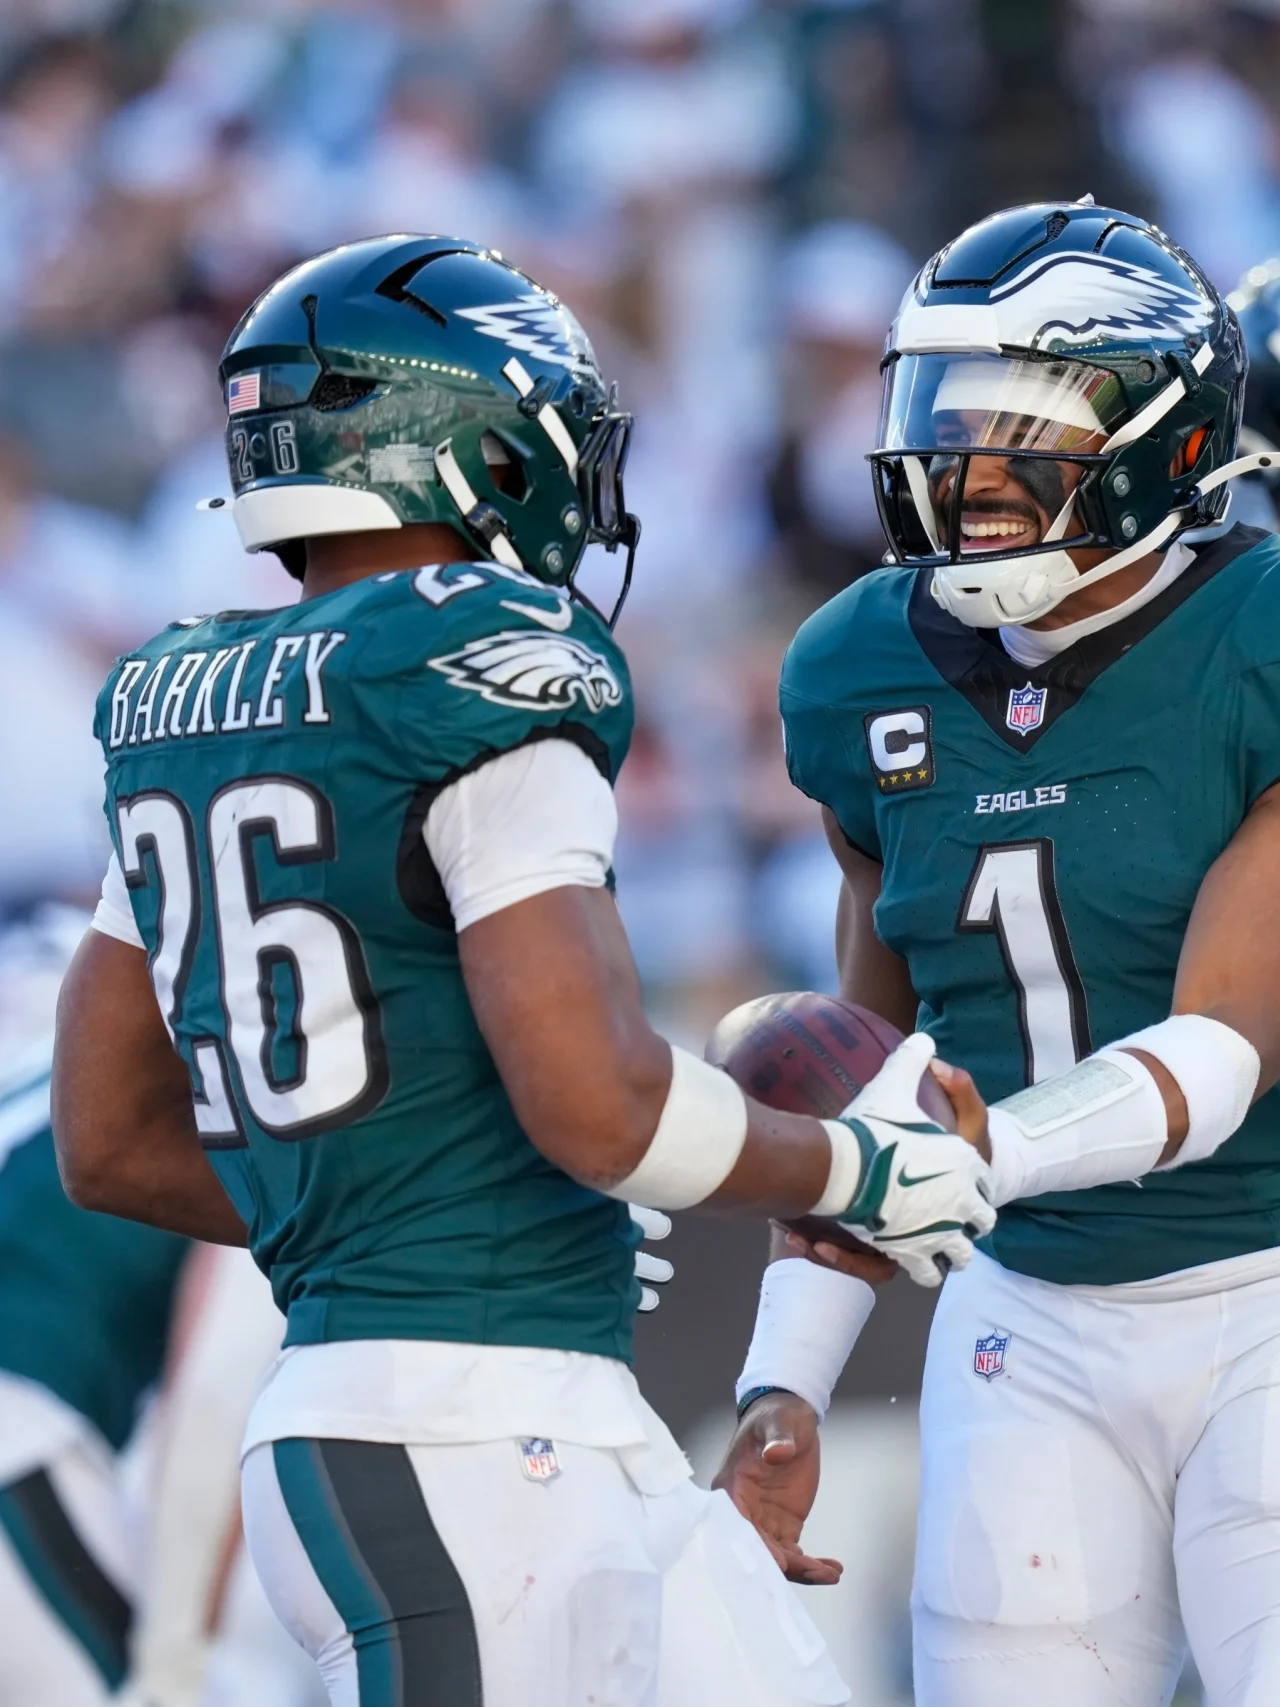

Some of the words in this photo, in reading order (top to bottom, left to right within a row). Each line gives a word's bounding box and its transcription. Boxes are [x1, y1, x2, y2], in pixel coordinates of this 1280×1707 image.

[106, 630, 349, 752] BARKLEY
[1012, 706, 1038, 726] NFL
[869, 711, 927, 773] C
[974, 783, 1067, 814] EAGLES
[114, 772, 392, 1150] 26
[955, 836, 1092, 1087] 1
[976, 1351, 1000, 1372] NFL
[527, 1454, 557, 1475] NFL
